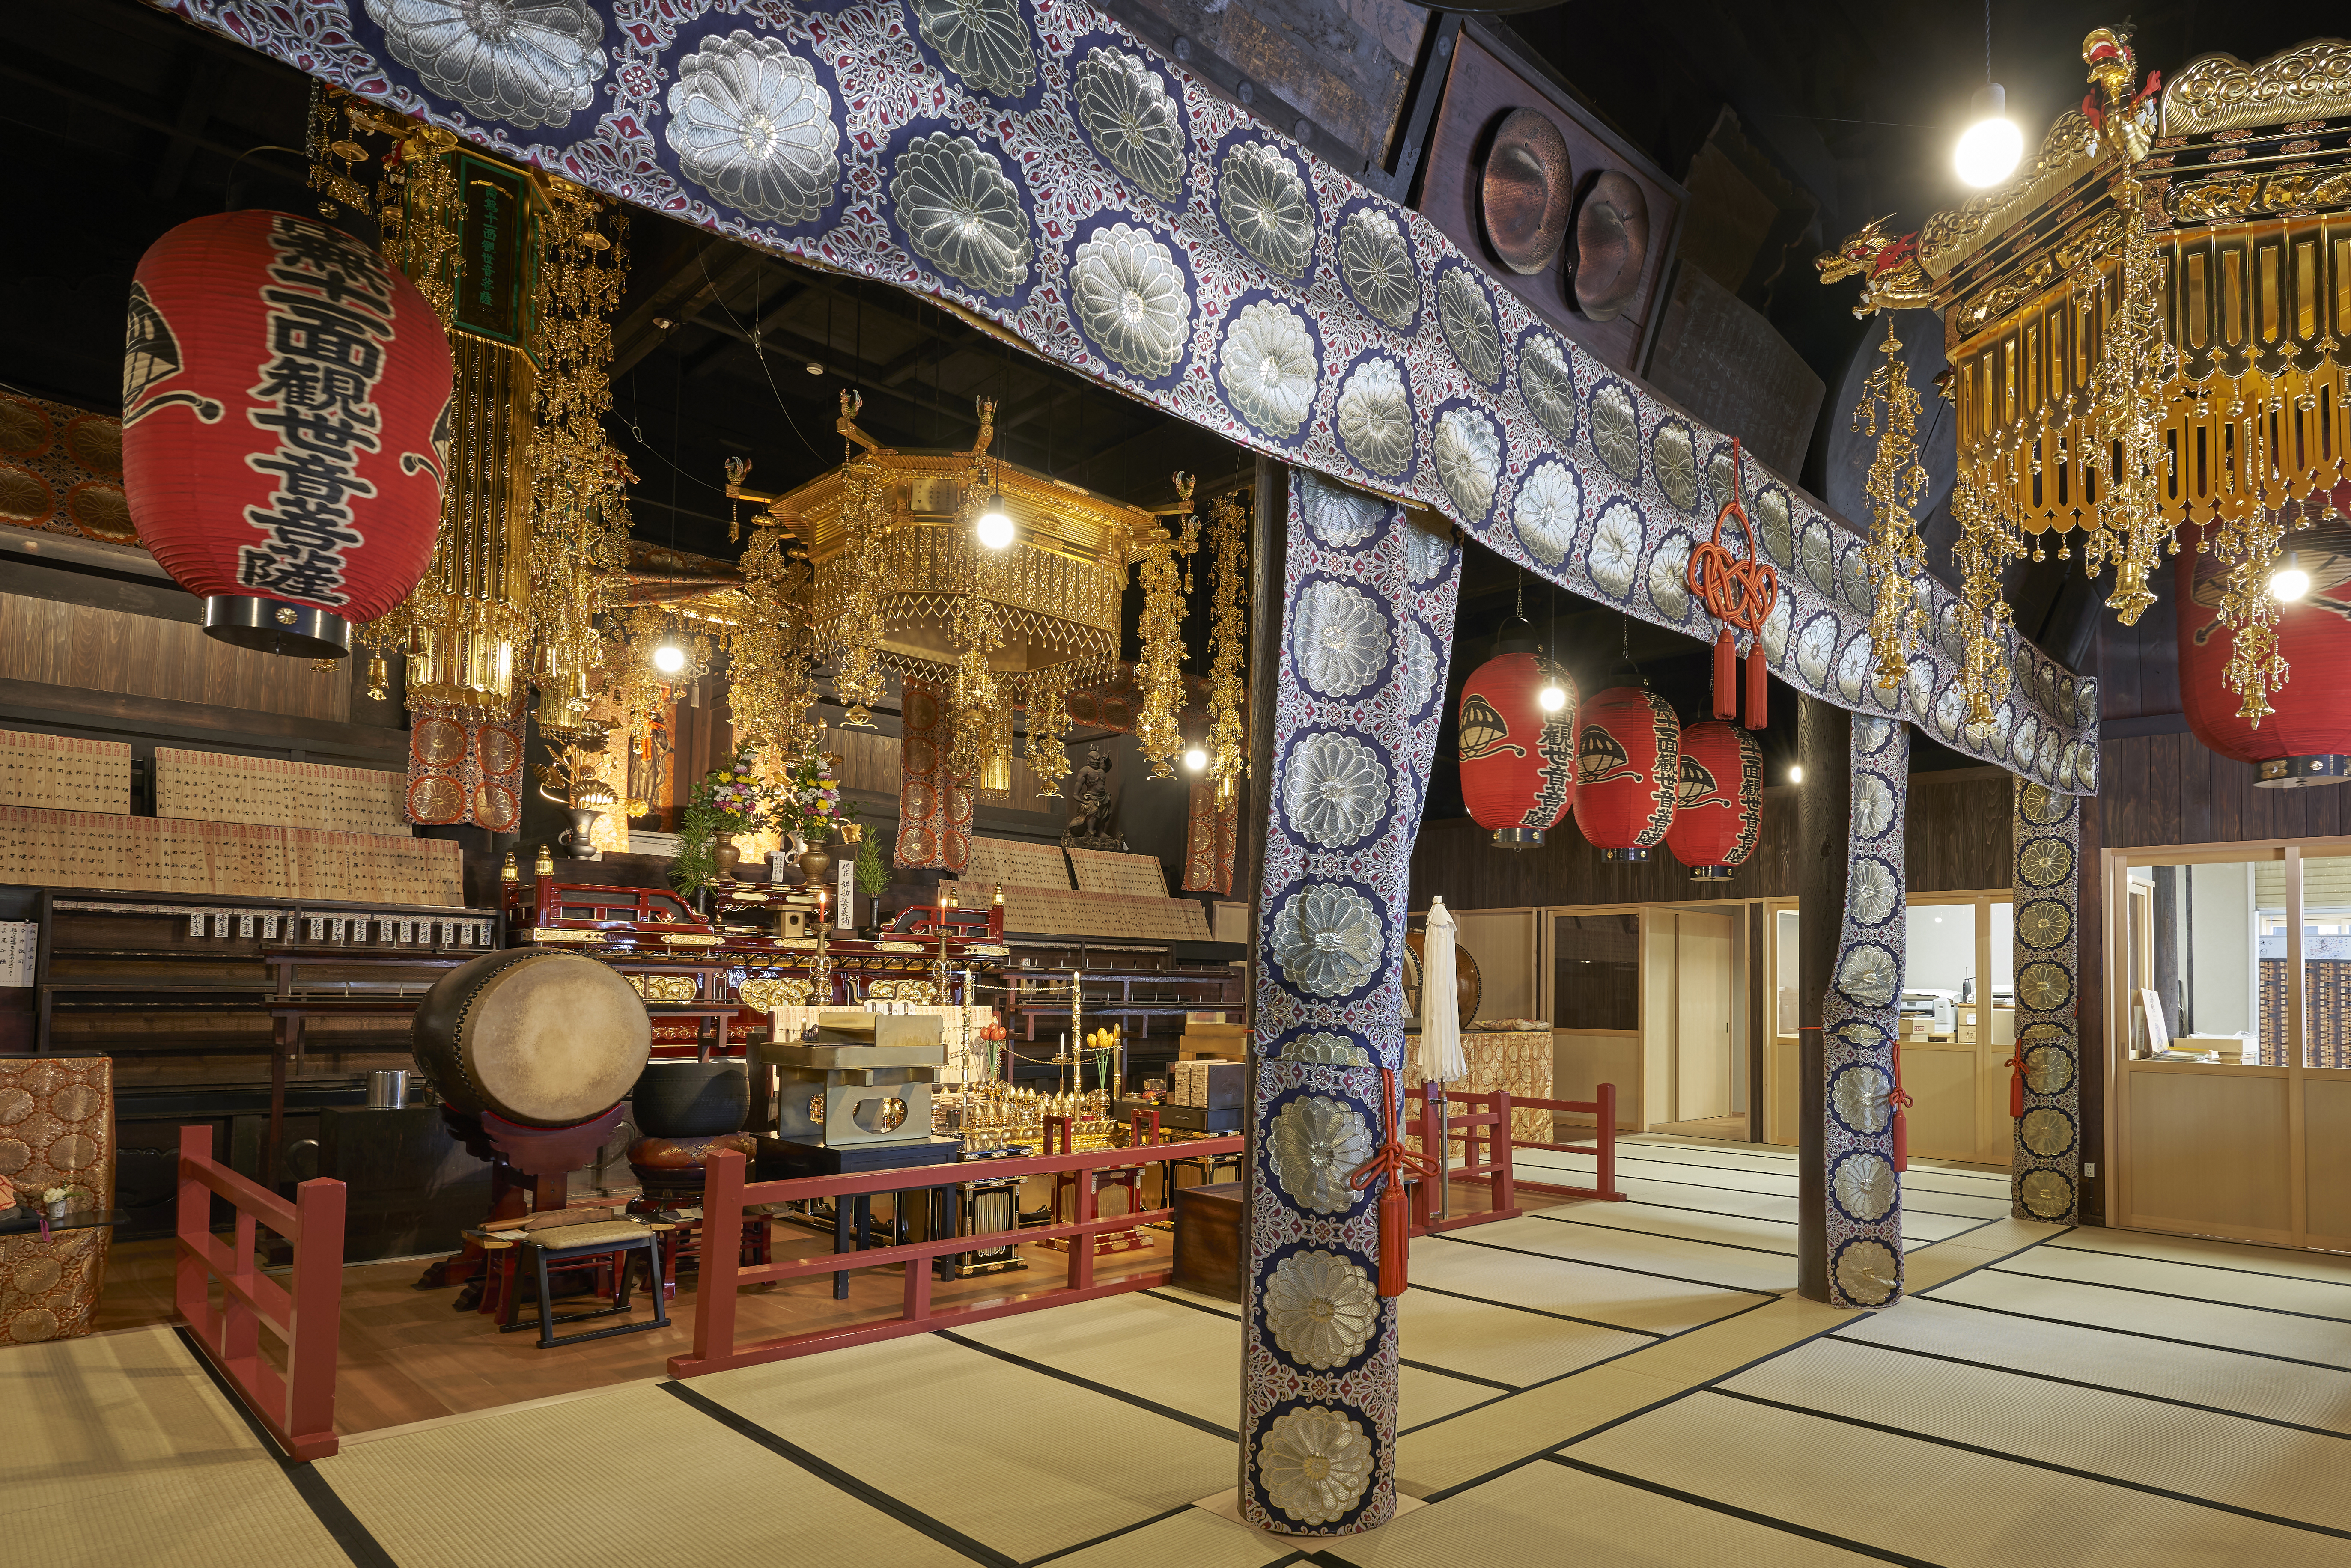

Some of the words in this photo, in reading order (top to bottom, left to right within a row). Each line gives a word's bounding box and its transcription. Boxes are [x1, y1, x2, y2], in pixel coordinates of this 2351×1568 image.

[480, 186, 498, 306] 南無十一面観世音菩薩
[1633, 690, 1679, 846] 無十一面観世音菩薩
[1722, 724, 1762, 865] 無十一面観世音菩薩
[842, 863, 850, 877] 供花
